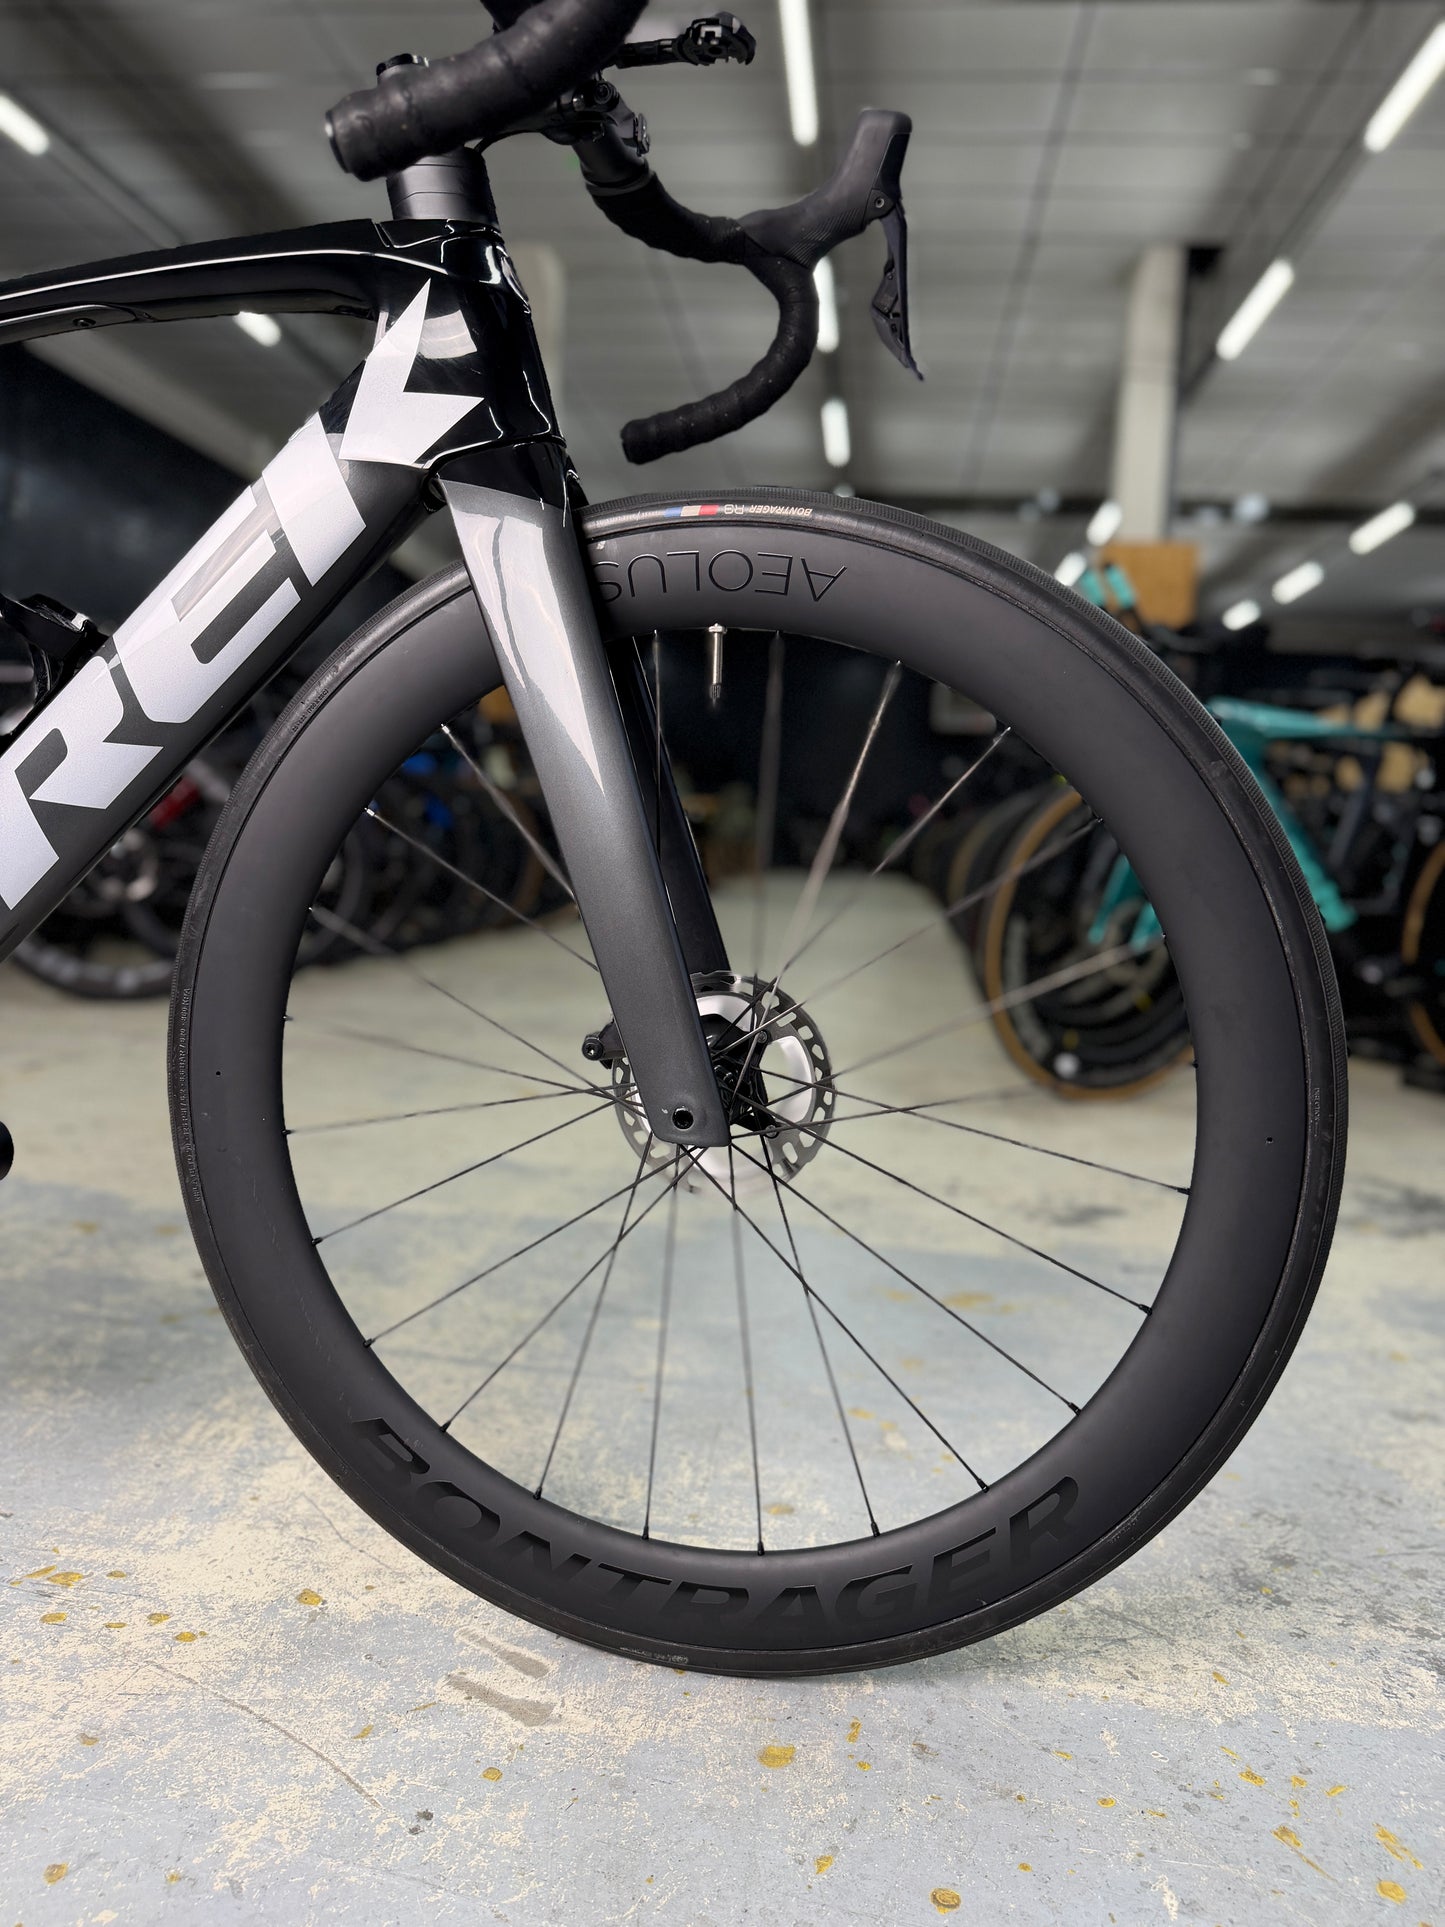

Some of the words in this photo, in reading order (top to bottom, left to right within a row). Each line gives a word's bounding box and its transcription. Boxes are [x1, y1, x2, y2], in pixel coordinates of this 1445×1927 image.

[748, 504, 813, 517] BONTRAGER
[593, 549, 848, 602] AEOLUS
[351, 1416, 1079, 1632] BONTRAGER
